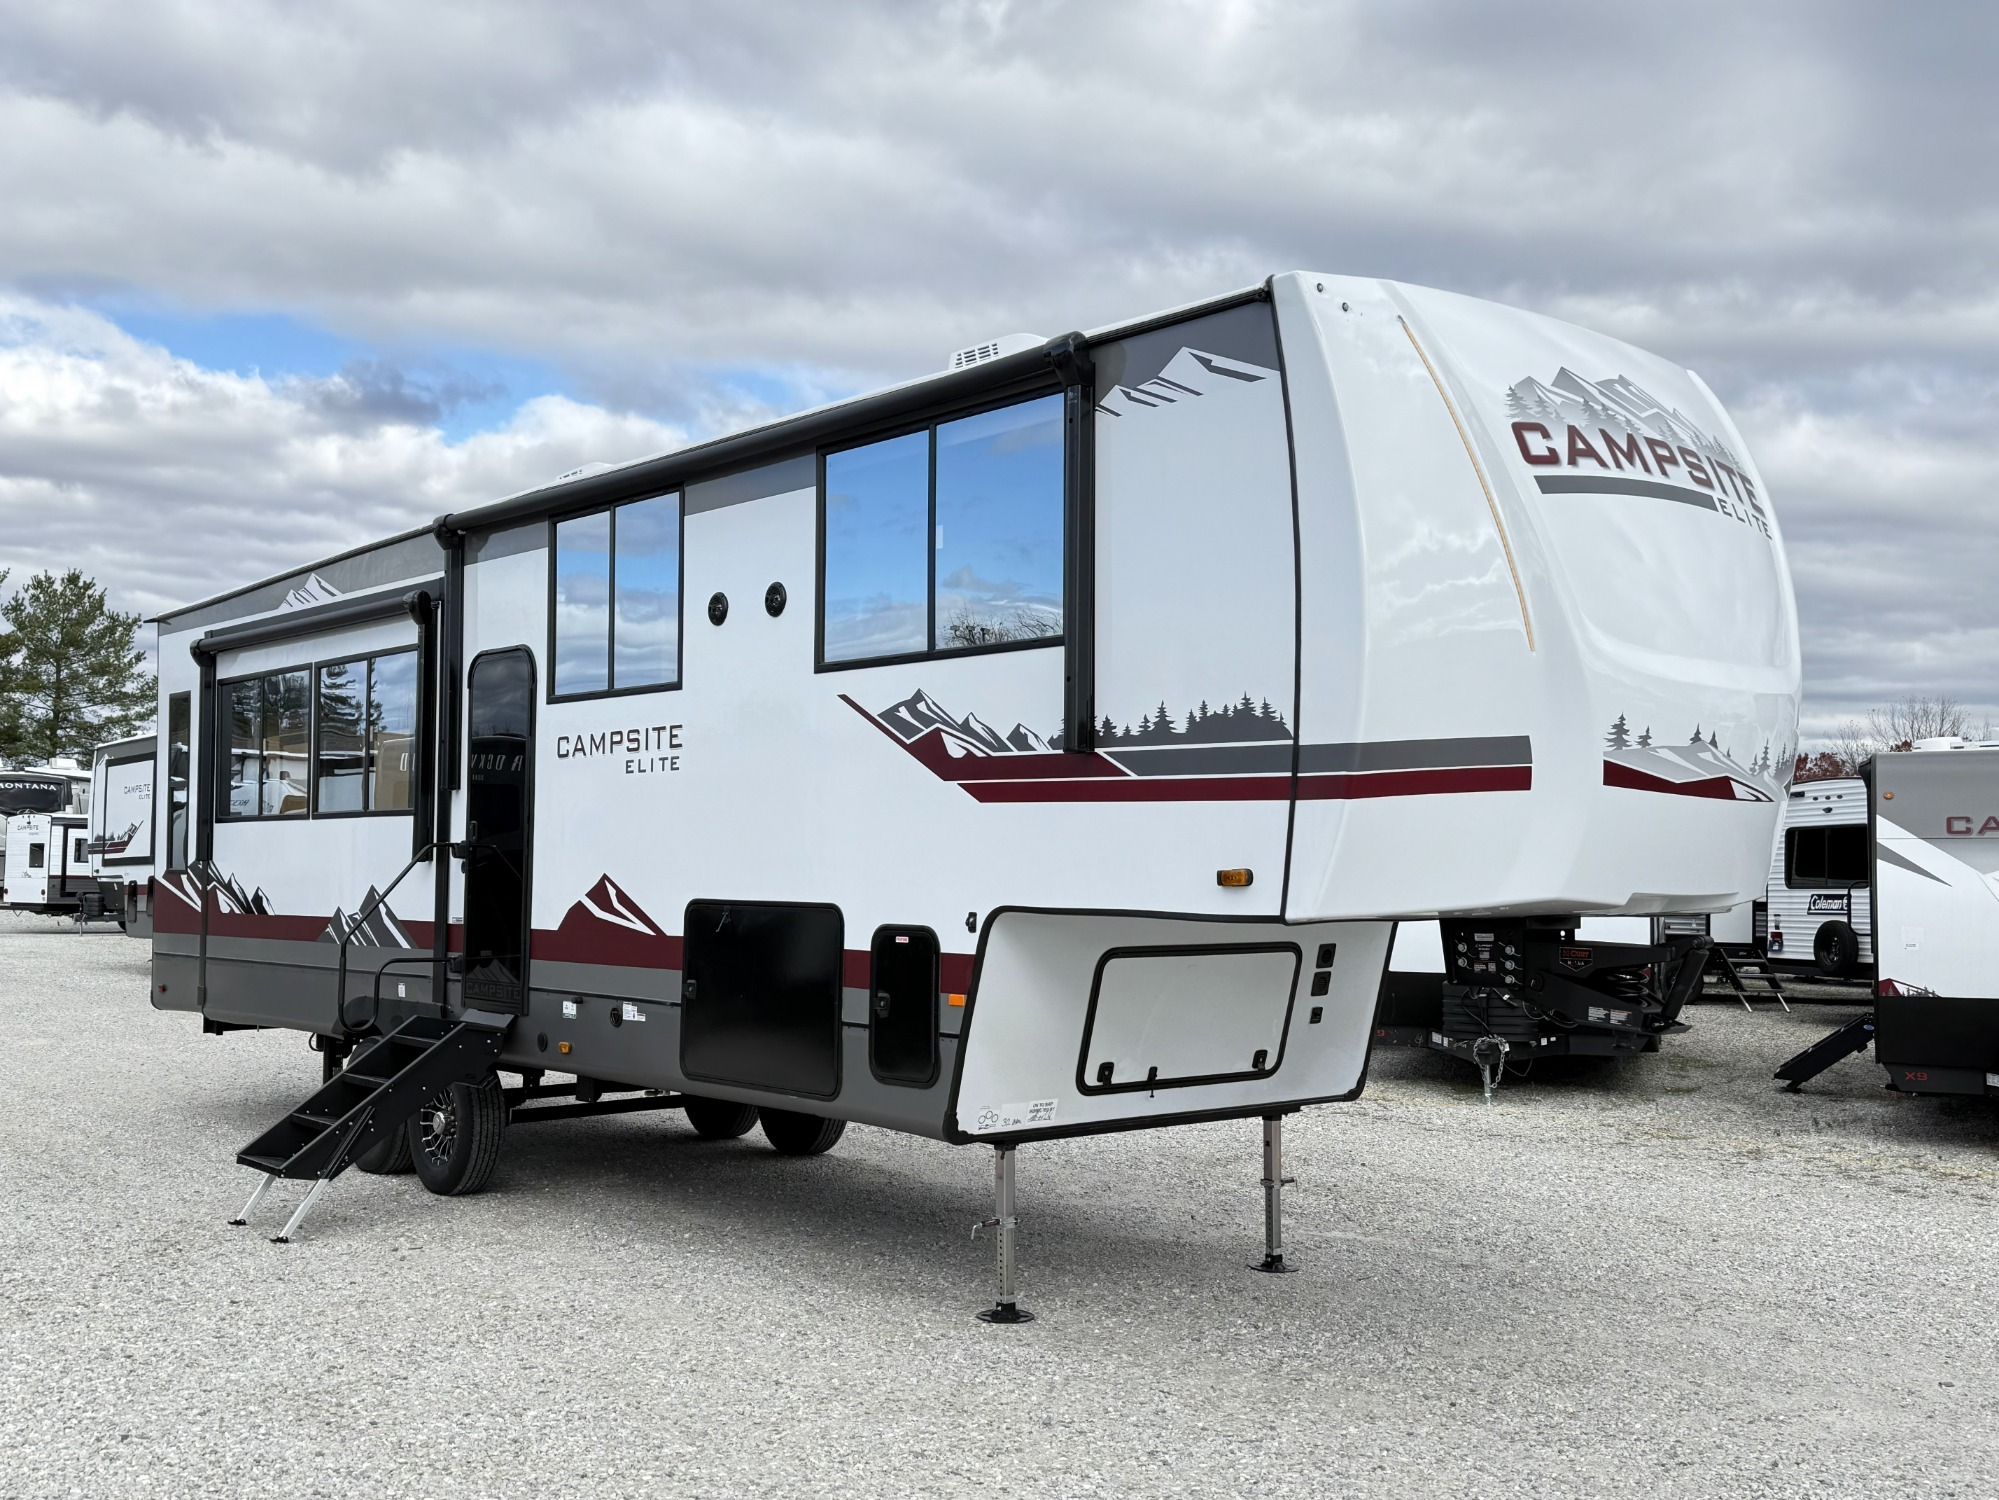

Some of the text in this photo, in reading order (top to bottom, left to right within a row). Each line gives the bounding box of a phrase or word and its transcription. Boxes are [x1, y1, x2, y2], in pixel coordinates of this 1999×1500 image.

[1511, 421, 1766, 518] CAMPSITE
[1717, 497, 1772, 541] ELITE
[557, 724, 683, 759] CAMPSITE
[625, 756, 680, 774] ELITE
[1811, 895, 1841, 910] Coleman
[466, 982, 520, 999] CAMPSITE
[1905, 1072, 1928, 1081] X9
